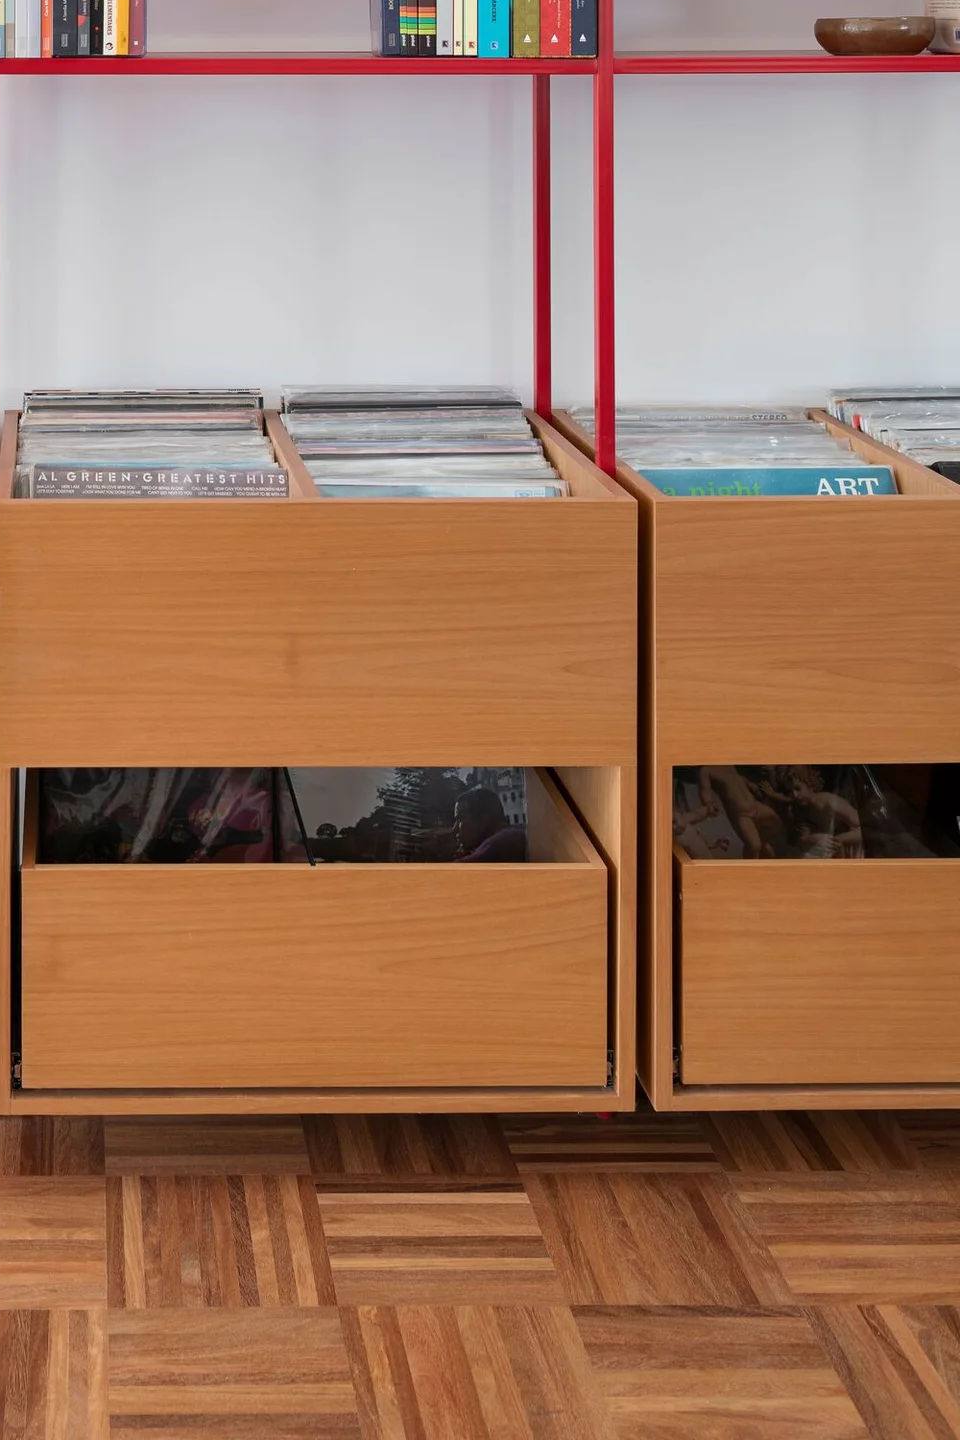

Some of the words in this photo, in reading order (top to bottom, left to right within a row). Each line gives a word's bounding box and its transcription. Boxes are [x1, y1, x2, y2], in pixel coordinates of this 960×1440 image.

[38, 471, 58, 482] AL
[66, 471, 132, 482] GREEN
[142, 473, 239, 484] GREATEST
[246, 474, 286, 485] HITS
[816, 477, 879, 496] ART
